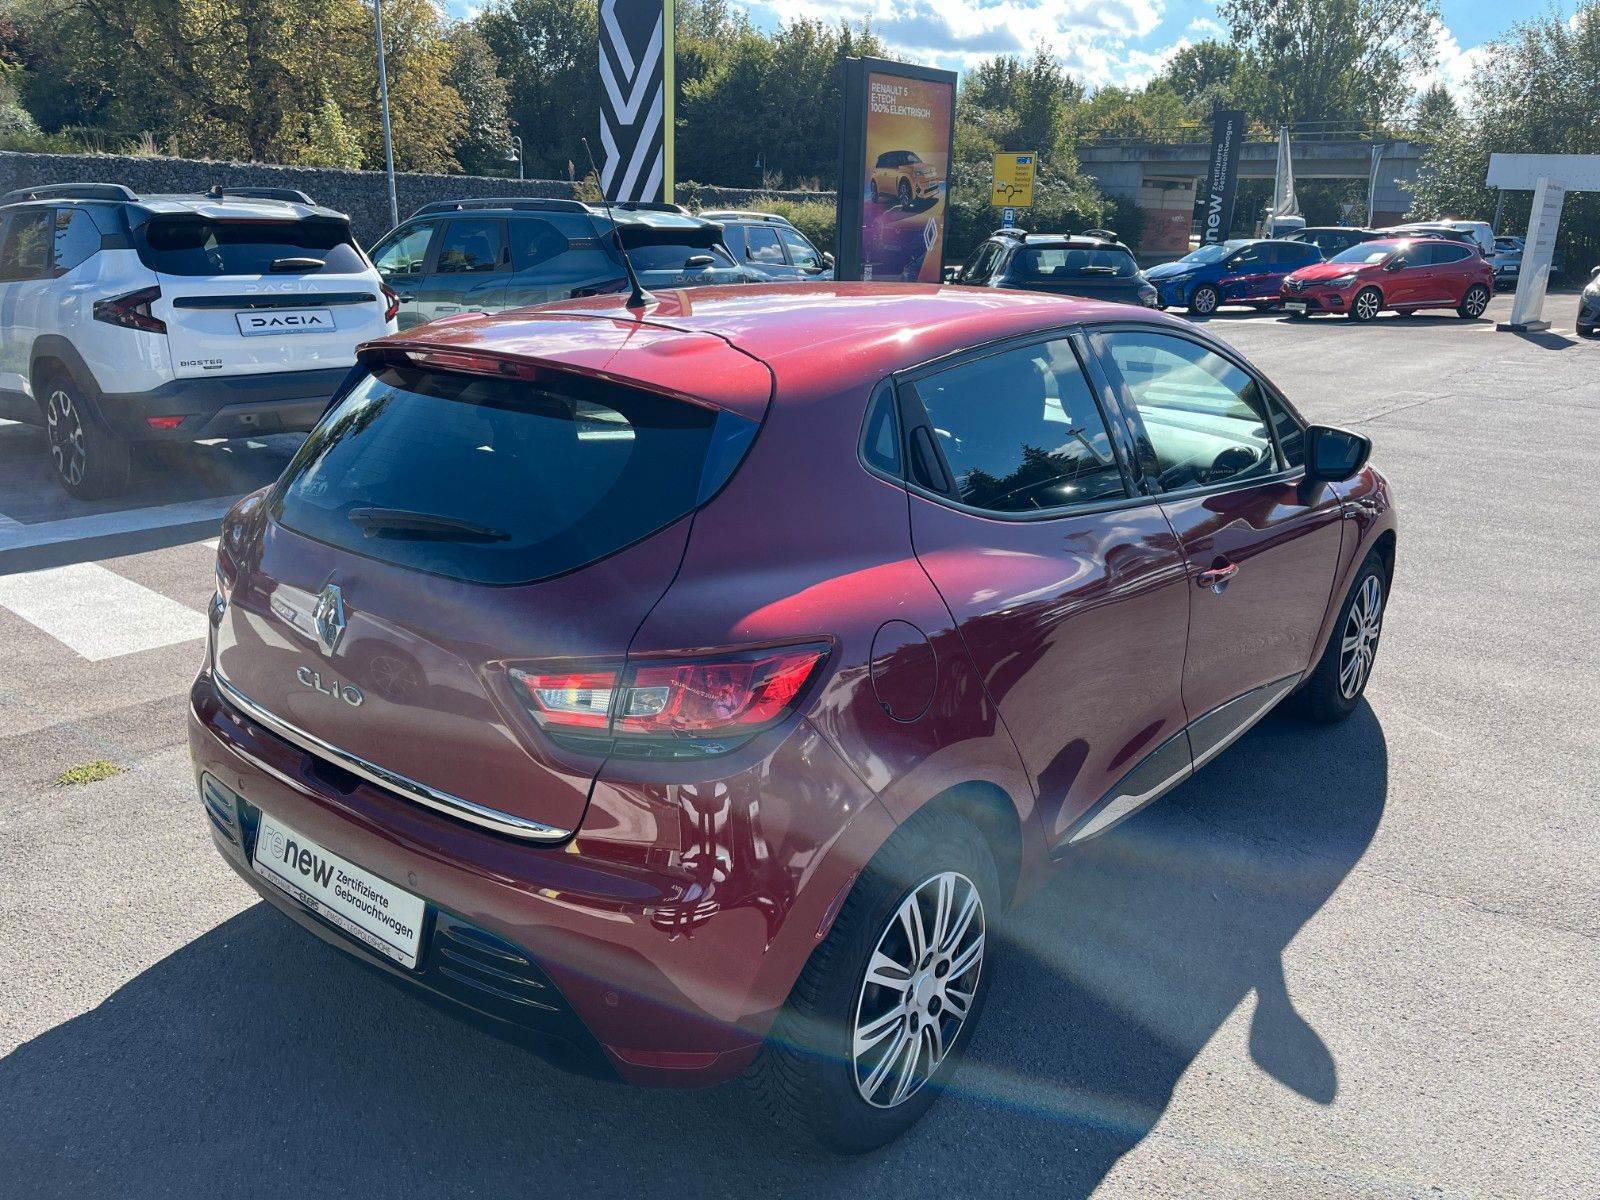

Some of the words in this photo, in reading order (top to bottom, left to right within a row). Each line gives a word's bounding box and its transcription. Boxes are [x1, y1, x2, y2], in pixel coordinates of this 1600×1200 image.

[871, 82, 903, 96] RENAULT
[903, 87, 908, 97] 5
[871, 93, 897, 104] E-TECH
[870, 102, 890, 114] 100%
[890, 105, 931, 118] ELEKTRISCH
[1212, 143, 1224, 191] Zertifizierte
[1218, 120, 1233, 191] Gebrauchtwagen
[1205, 194, 1223, 244] new
[245, 282, 320, 293] DACIA
[251, 316, 322, 327] DACIA
[180, 359, 223, 367] BIGSTER
[297, 666, 363, 707] CLIO
[262, 824, 335, 889] renew
[336, 869, 389, 908] Zertifizierte
[334, 884, 413, 940] Gebrauchtwagen
